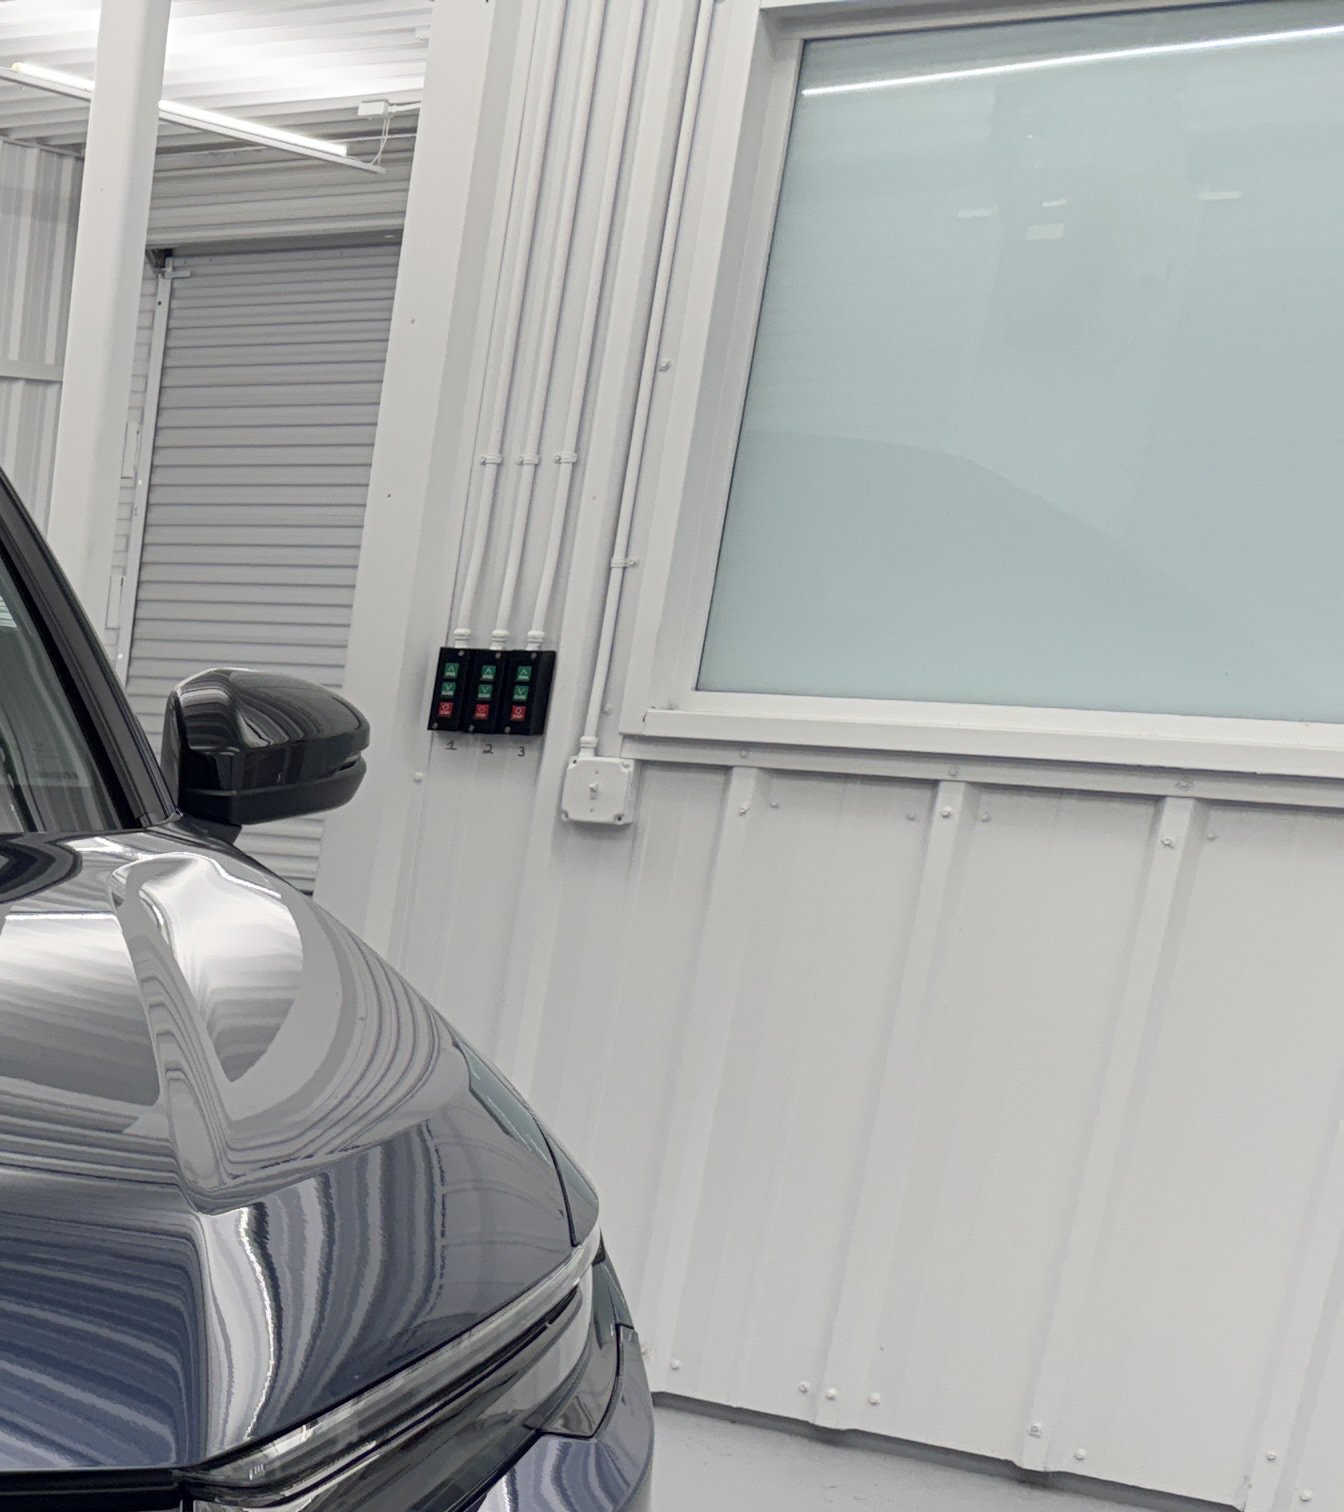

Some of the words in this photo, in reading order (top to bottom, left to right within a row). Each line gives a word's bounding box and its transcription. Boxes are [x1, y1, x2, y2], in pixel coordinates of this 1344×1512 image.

[445, 740, 457, 750] 1
[482, 744, 493, 754] 2
[517, 746, 526, 757] 3
